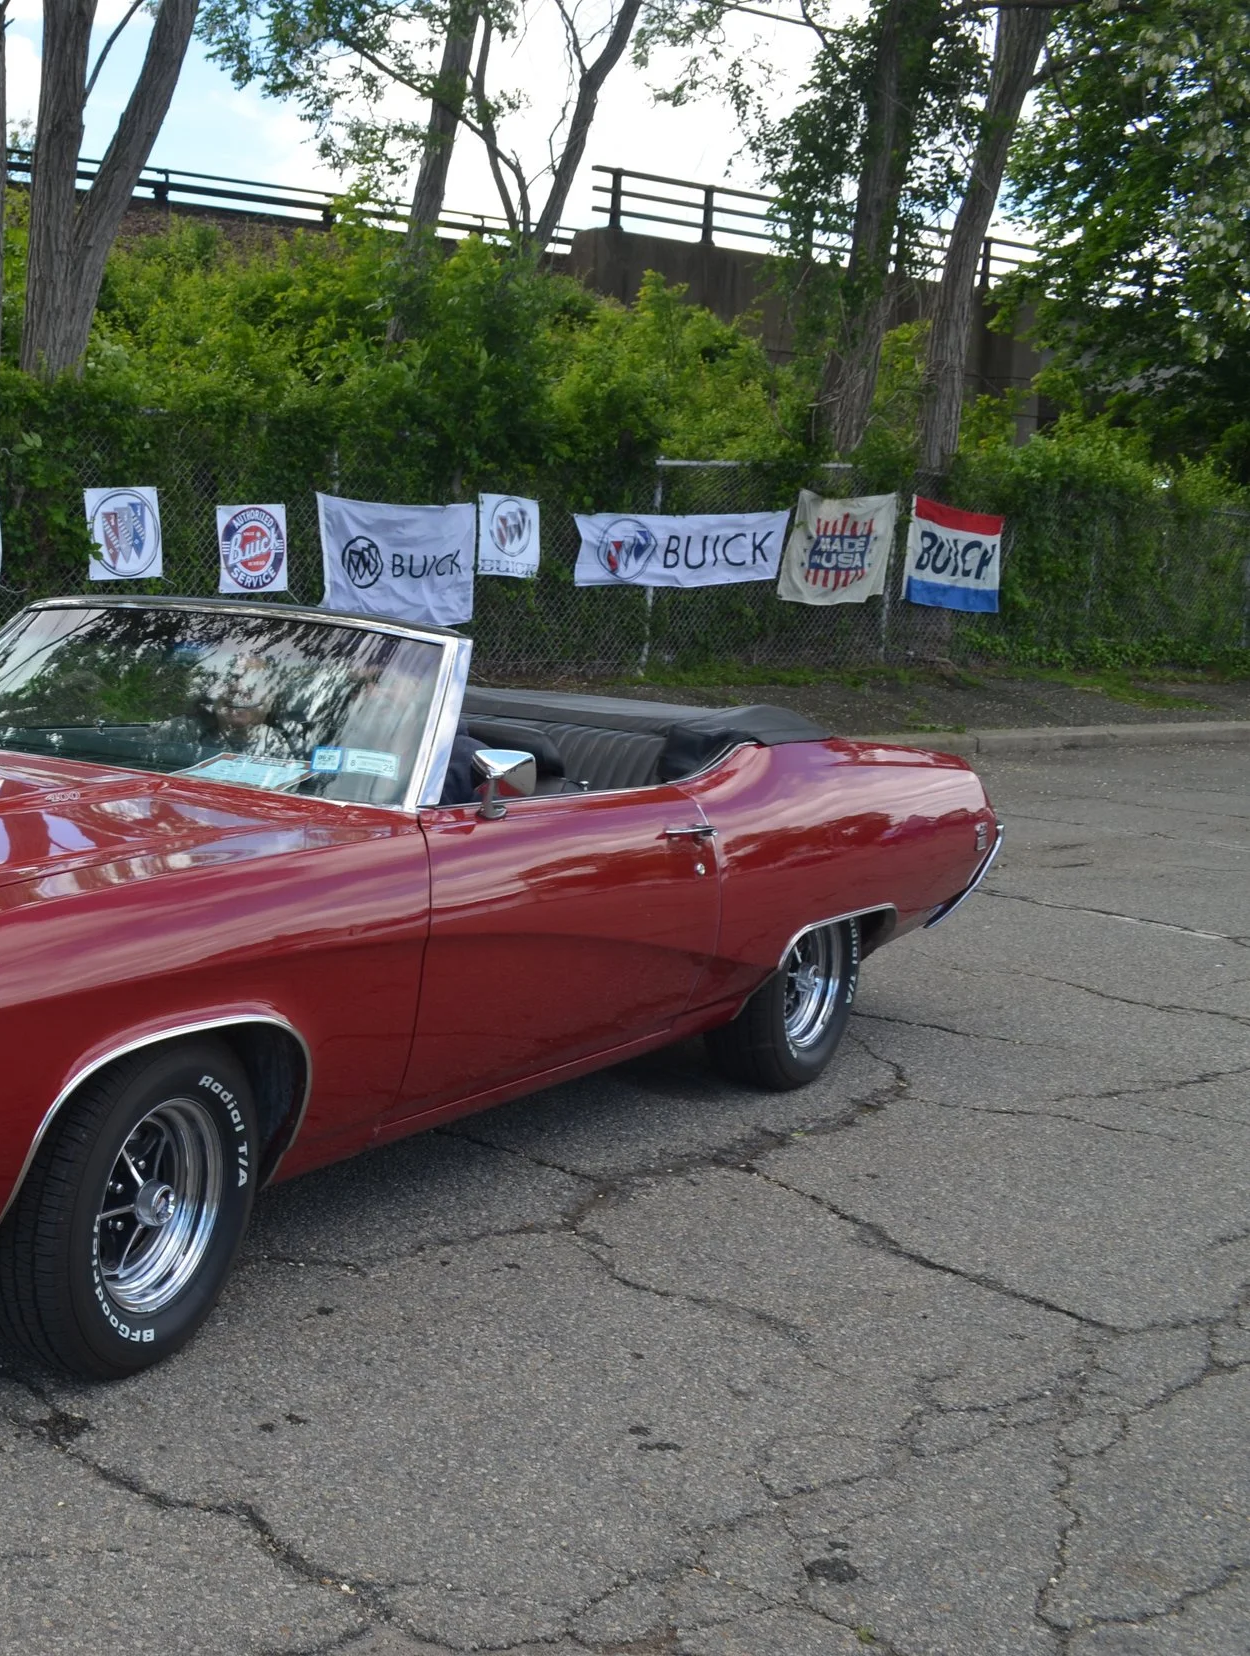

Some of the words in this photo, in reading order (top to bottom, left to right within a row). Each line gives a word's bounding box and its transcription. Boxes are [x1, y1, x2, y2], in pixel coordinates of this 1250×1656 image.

[232, 509, 274, 530] AUTHORIZED
[229, 526, 280, 567] Buick
[663, 530, 775, 570] BUICK
[815, 536, 867, 553] MADE
[391, 549, 462, 579] BUICK
[479, 559, 538, 576] BUICK
[821, 552, 863, 569] USA
[230, 566, 277, 588] SERVICE
[44, 790, 81, 803] 400
[849, 917, 859, 965] adial
[237, 1140, 249, 1188] T/A
